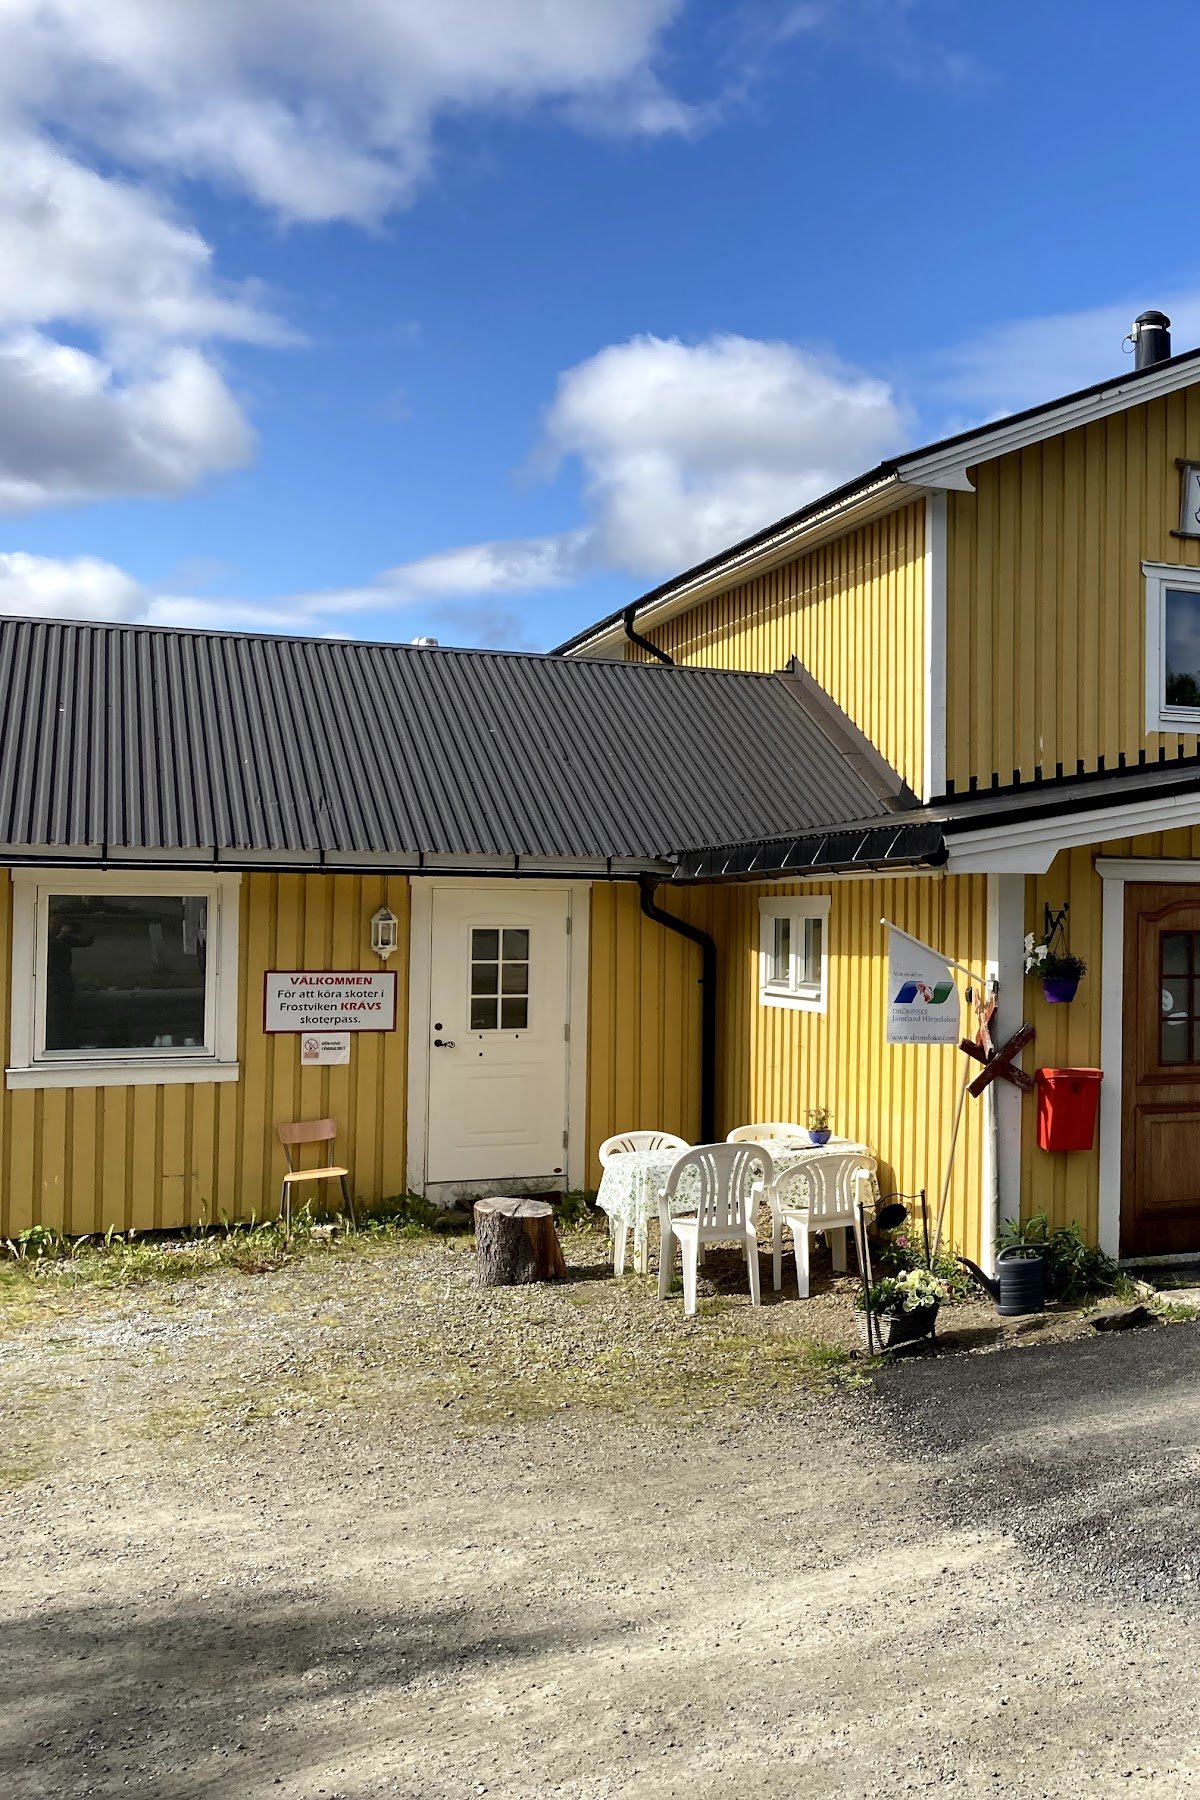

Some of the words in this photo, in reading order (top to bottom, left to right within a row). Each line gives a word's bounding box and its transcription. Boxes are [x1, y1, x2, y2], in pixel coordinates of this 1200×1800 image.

[290, 976, 373, 985] VÄLKOMMEN
[277, 989, 296, 998] För
[299, 990, 314, 998] att
[317, 989, 342, 998] köra
[344, 989, 378, 998] skoter
[280, 1002, 337, 1011] Frostviken
[340, 1001, 382, 1011] KRÄVS
[300, 1016, 361, 1025] skoterpass.
